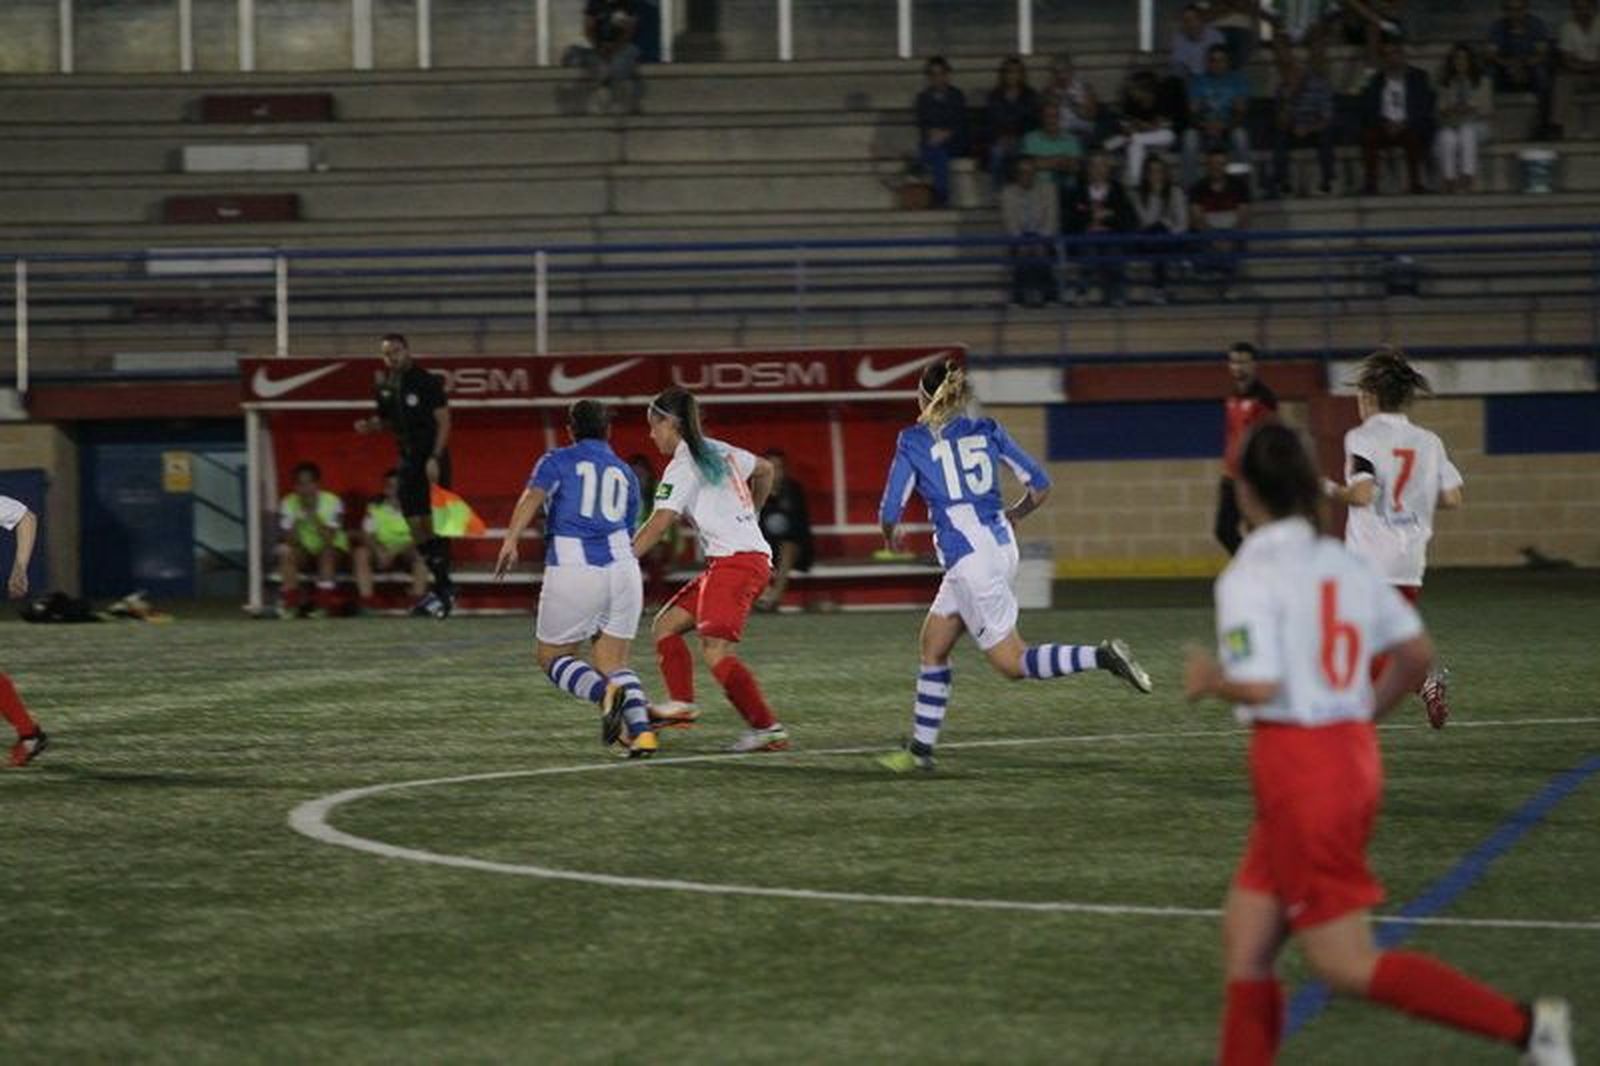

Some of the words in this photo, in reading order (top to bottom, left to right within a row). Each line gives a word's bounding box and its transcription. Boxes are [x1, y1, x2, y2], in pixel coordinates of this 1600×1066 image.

[374, 368, 529, 394] SM
[671, 362, 827, 388] UDSM
[575, 460, 629, 523] 10
[931, 435, 993, 500] 15
[1391, 448, 1416, 513] 7
[1319, 578, 1361, 691] 6
